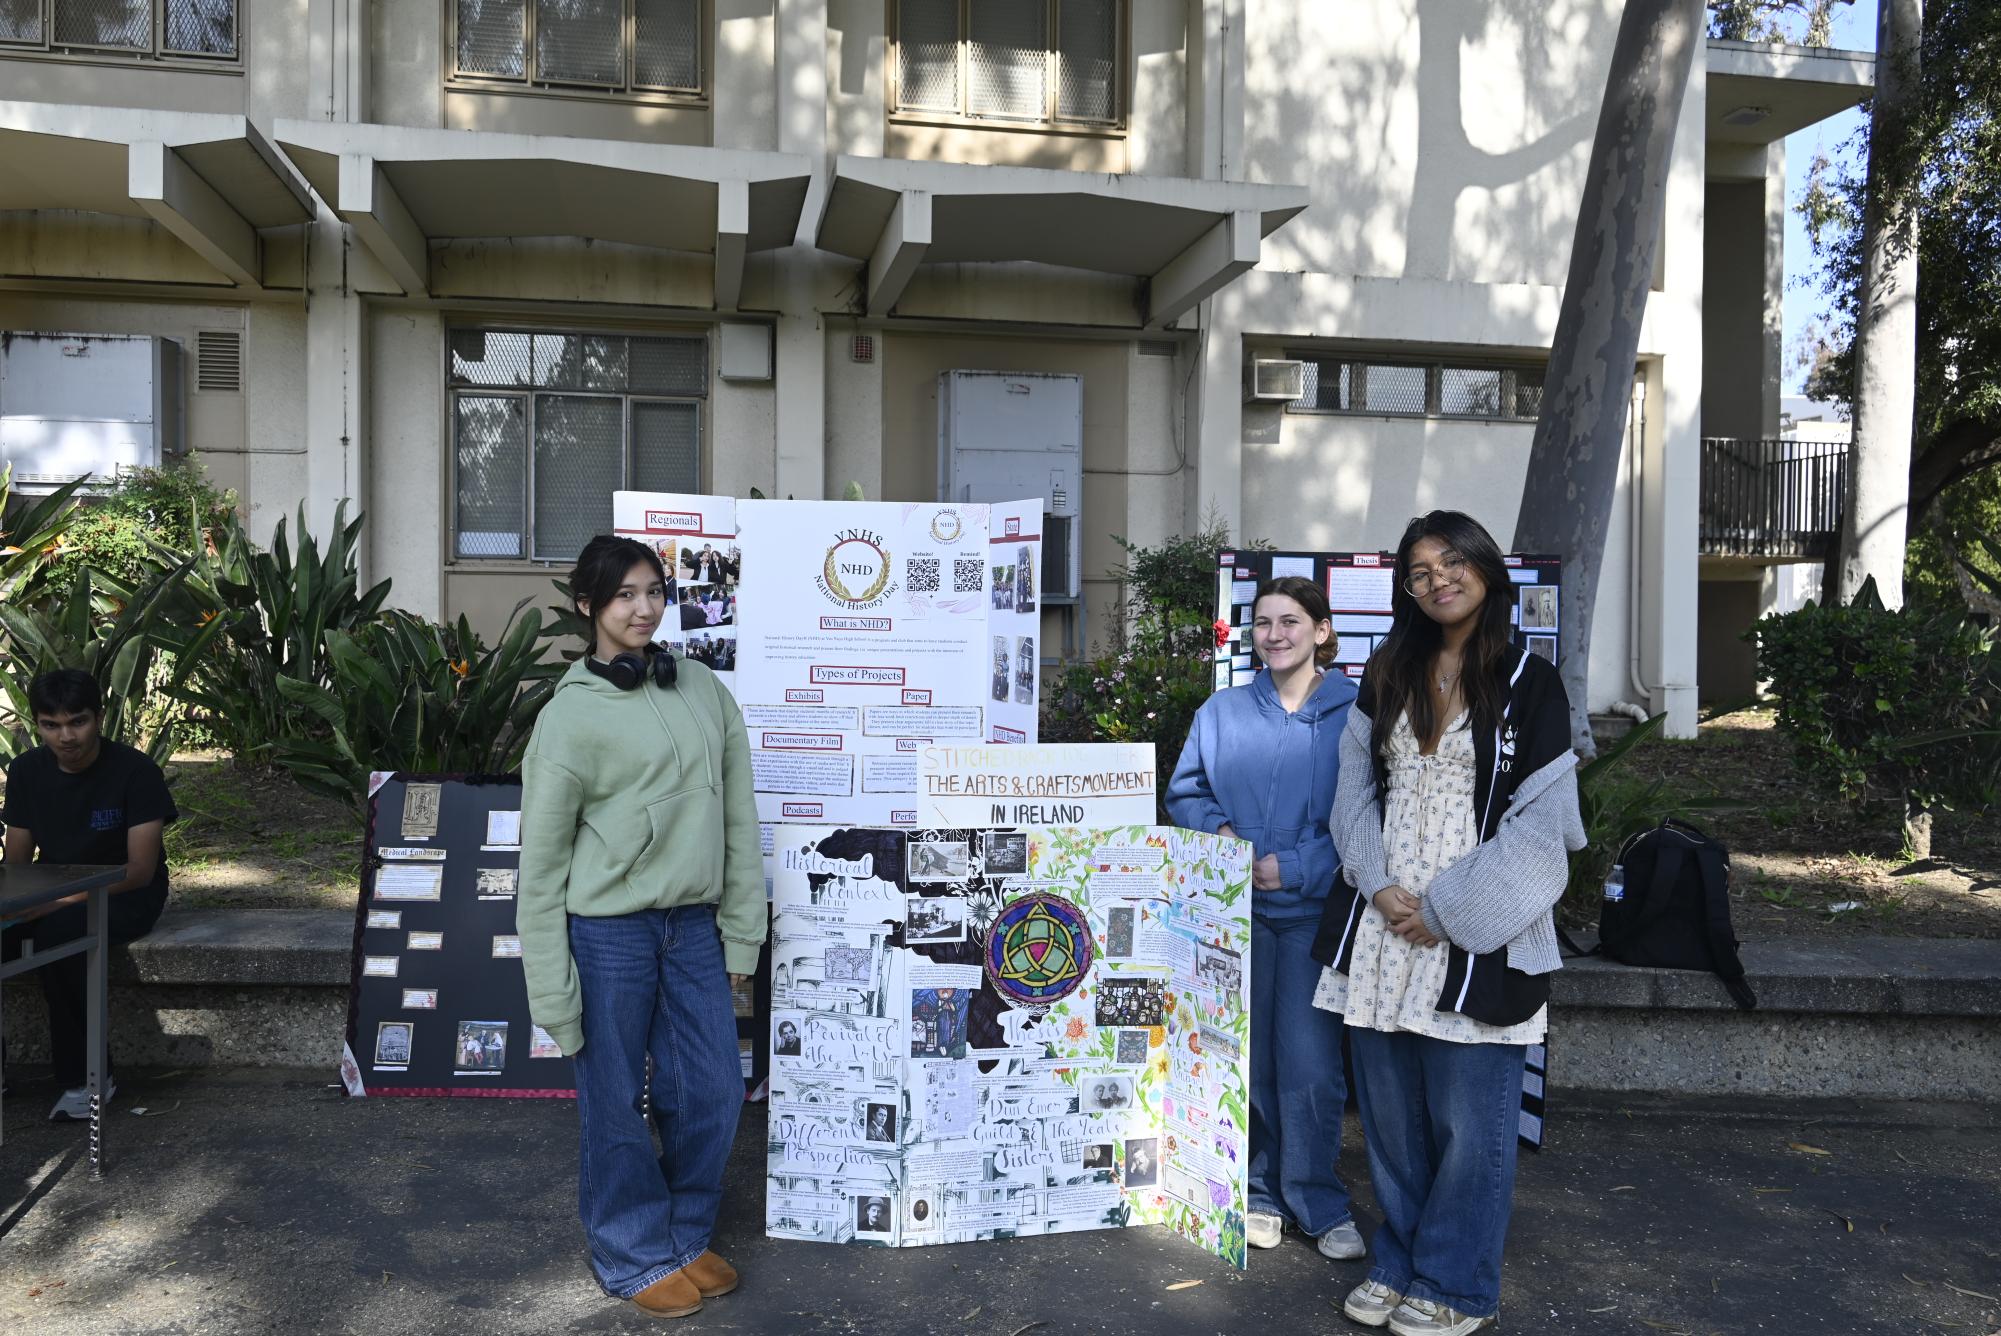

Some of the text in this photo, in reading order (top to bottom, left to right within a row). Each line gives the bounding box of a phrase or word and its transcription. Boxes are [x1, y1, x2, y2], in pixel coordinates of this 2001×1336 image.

[650, 513, 698, 527] Regionals
[834, 528, 883, 547] VNHS
[841, 563, 873, 576] NHD
[814, 574, 900, 610] National History Day
[823, 618, 889, 629] What is NHD?
[815, 668, 902, 682] Types of Projects
[788, 691, 820, 700] Exhibits
[905, 692, 928, 701] Paper
[766, 735, 839, 746] Documentary Film
[924, 774, 959, 793] THE
[965, 775, 1008, 795] ARTS
[786, 806, 820, 815] Podcasts
[991, 803, 1084, 824] IN IRELAND
[381, 848, 444, 857] Medical Landscape
[785, 849, 871, 874] Historical
[826, 880, 894, 901] Context
[810, 1020, 871, 1041] Revival
[1010, 1013, 1060, 1042] Thesis
[990, 1097, 1061, 1117] Dun Emer
[780, 1121, 861, 1147] Different
[973, 1125, 1013, 1145] Guild
[1080, 1119, 1120, 1135] Yeats
[787, 1141, 872, 1168] Perspectives
[1003, 1149, 1054, 1169] Sisters
